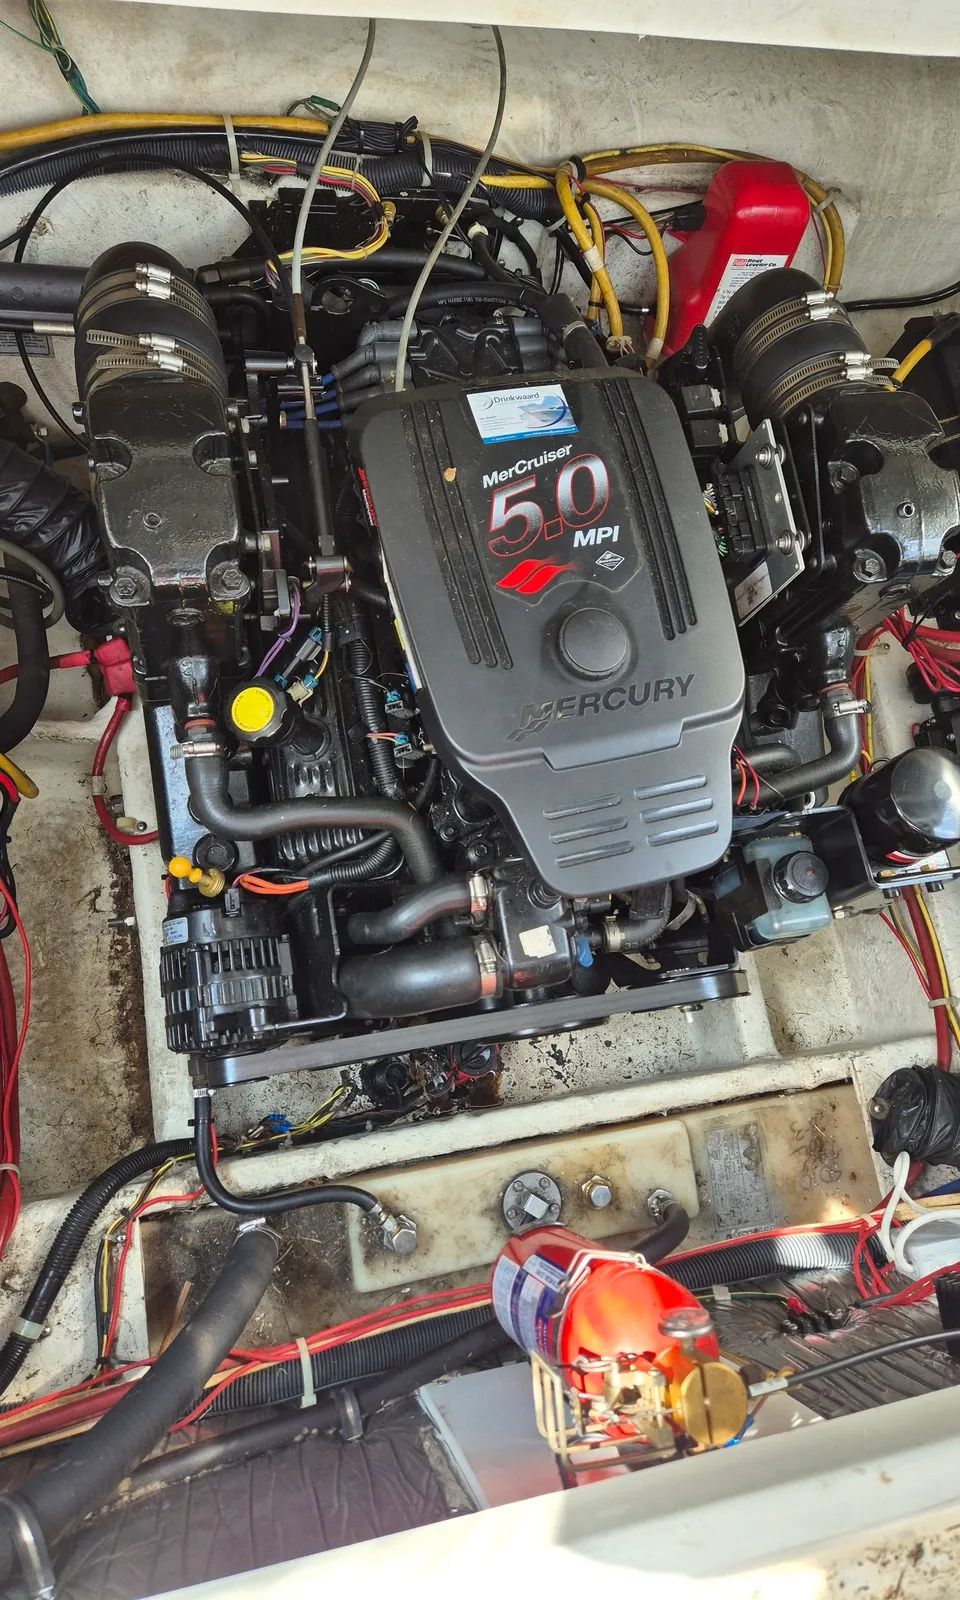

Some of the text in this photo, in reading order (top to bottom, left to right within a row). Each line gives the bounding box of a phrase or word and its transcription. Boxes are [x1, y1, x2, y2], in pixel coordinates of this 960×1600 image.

[493, 392, 540, 404] Drinkwaard
[482, 443, 573, 489] MerCruiser
[488, 453, 610, 557] 5.0
[573, 525, 620, 548] MPI
[507, 673, 695, 742] MERCURY
